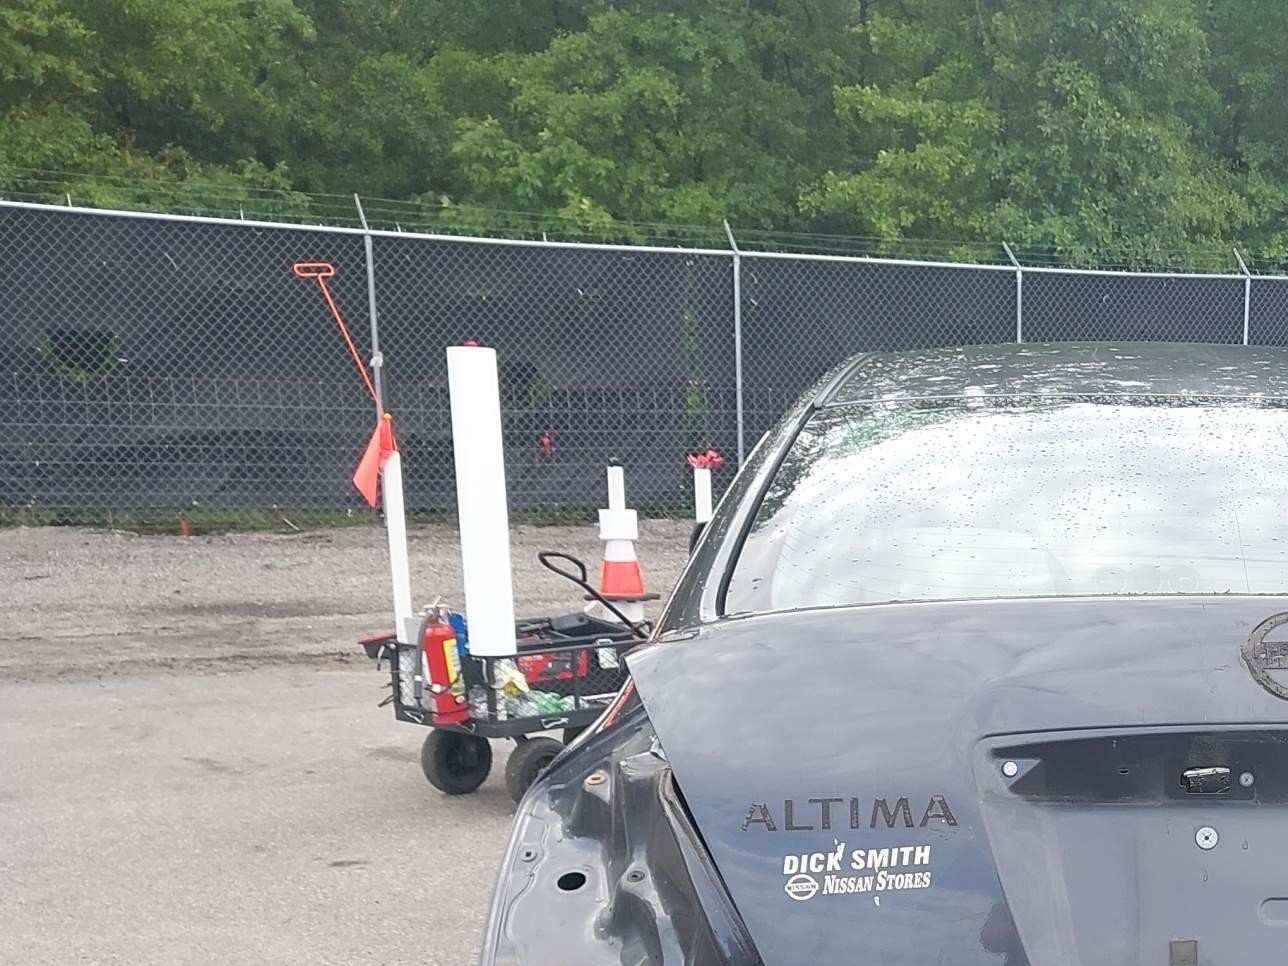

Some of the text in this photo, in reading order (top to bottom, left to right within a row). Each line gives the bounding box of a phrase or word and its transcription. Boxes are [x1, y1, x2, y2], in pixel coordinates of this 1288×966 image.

[741, 795, 959, 832] ALTIMA
[784, 845, 931, 875] DICK SMITH
